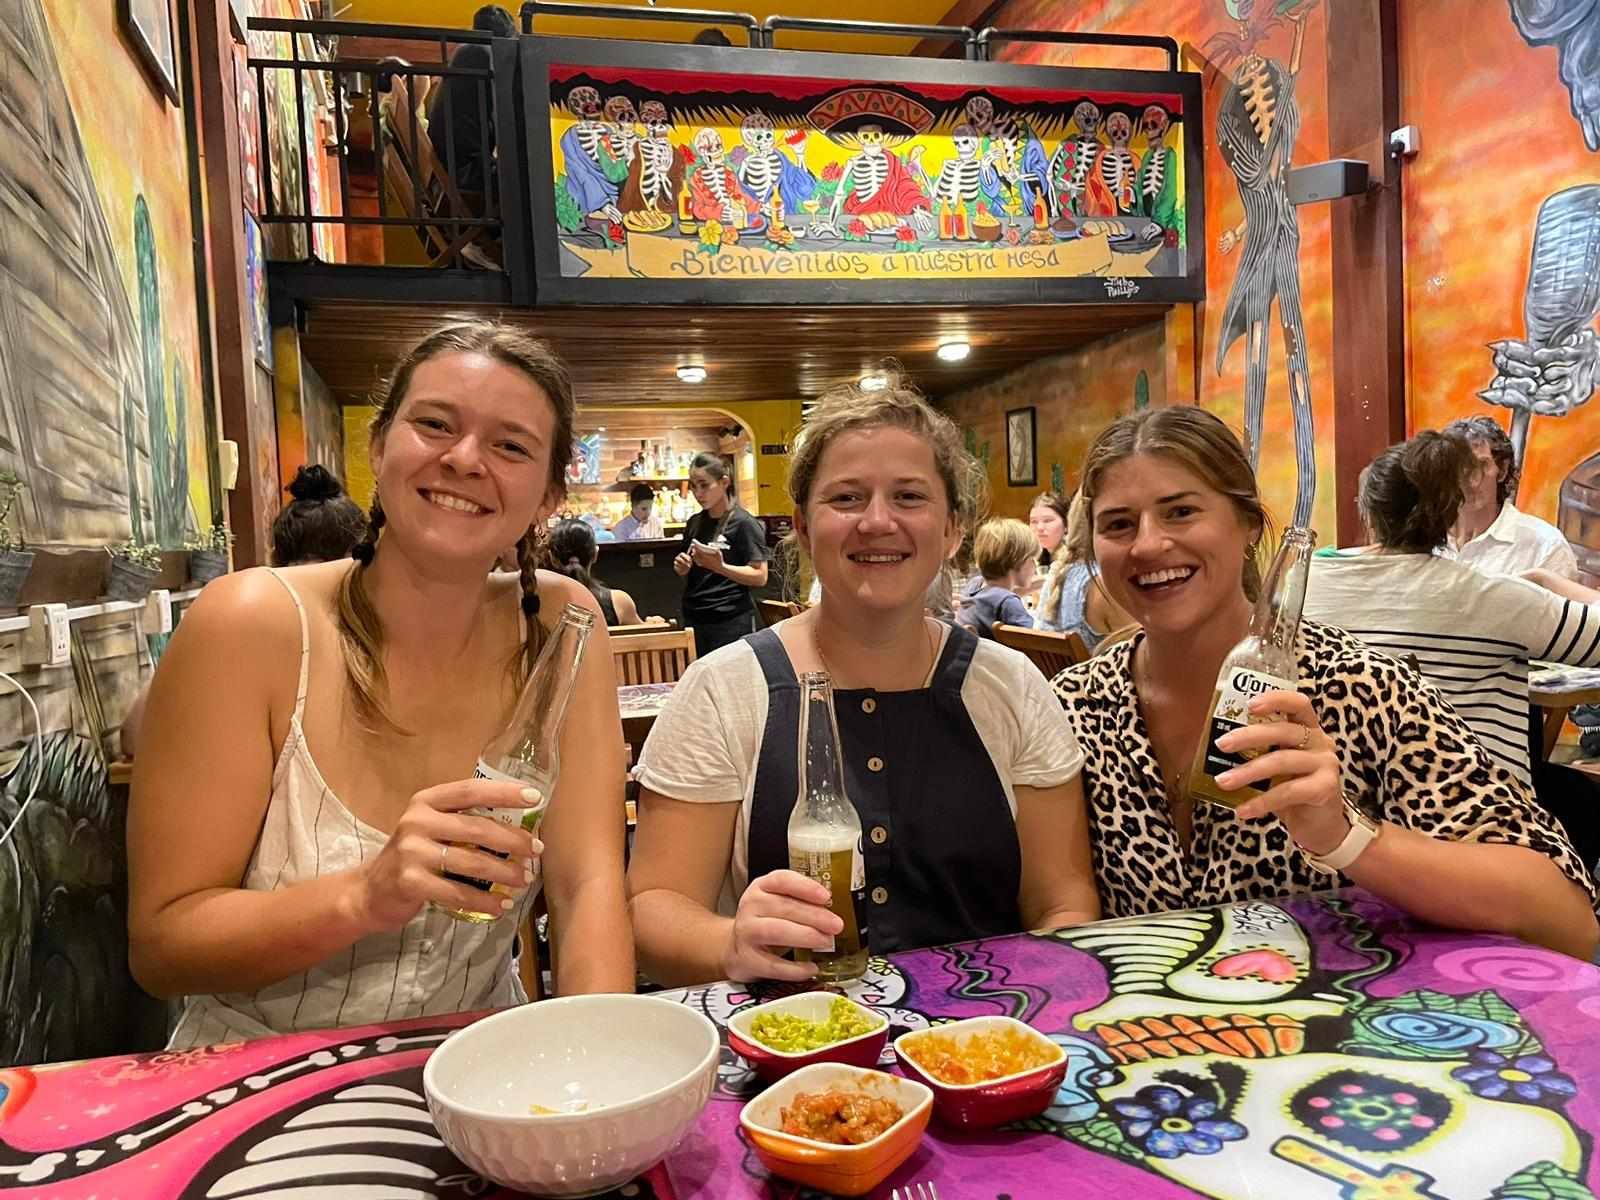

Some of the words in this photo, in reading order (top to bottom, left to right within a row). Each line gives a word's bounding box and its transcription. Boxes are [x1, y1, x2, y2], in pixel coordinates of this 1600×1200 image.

[671, 249, 869, 276] Bienvenidos
[882, 256, 898, 272] a
[904, 251, 996, 272] nuestra
